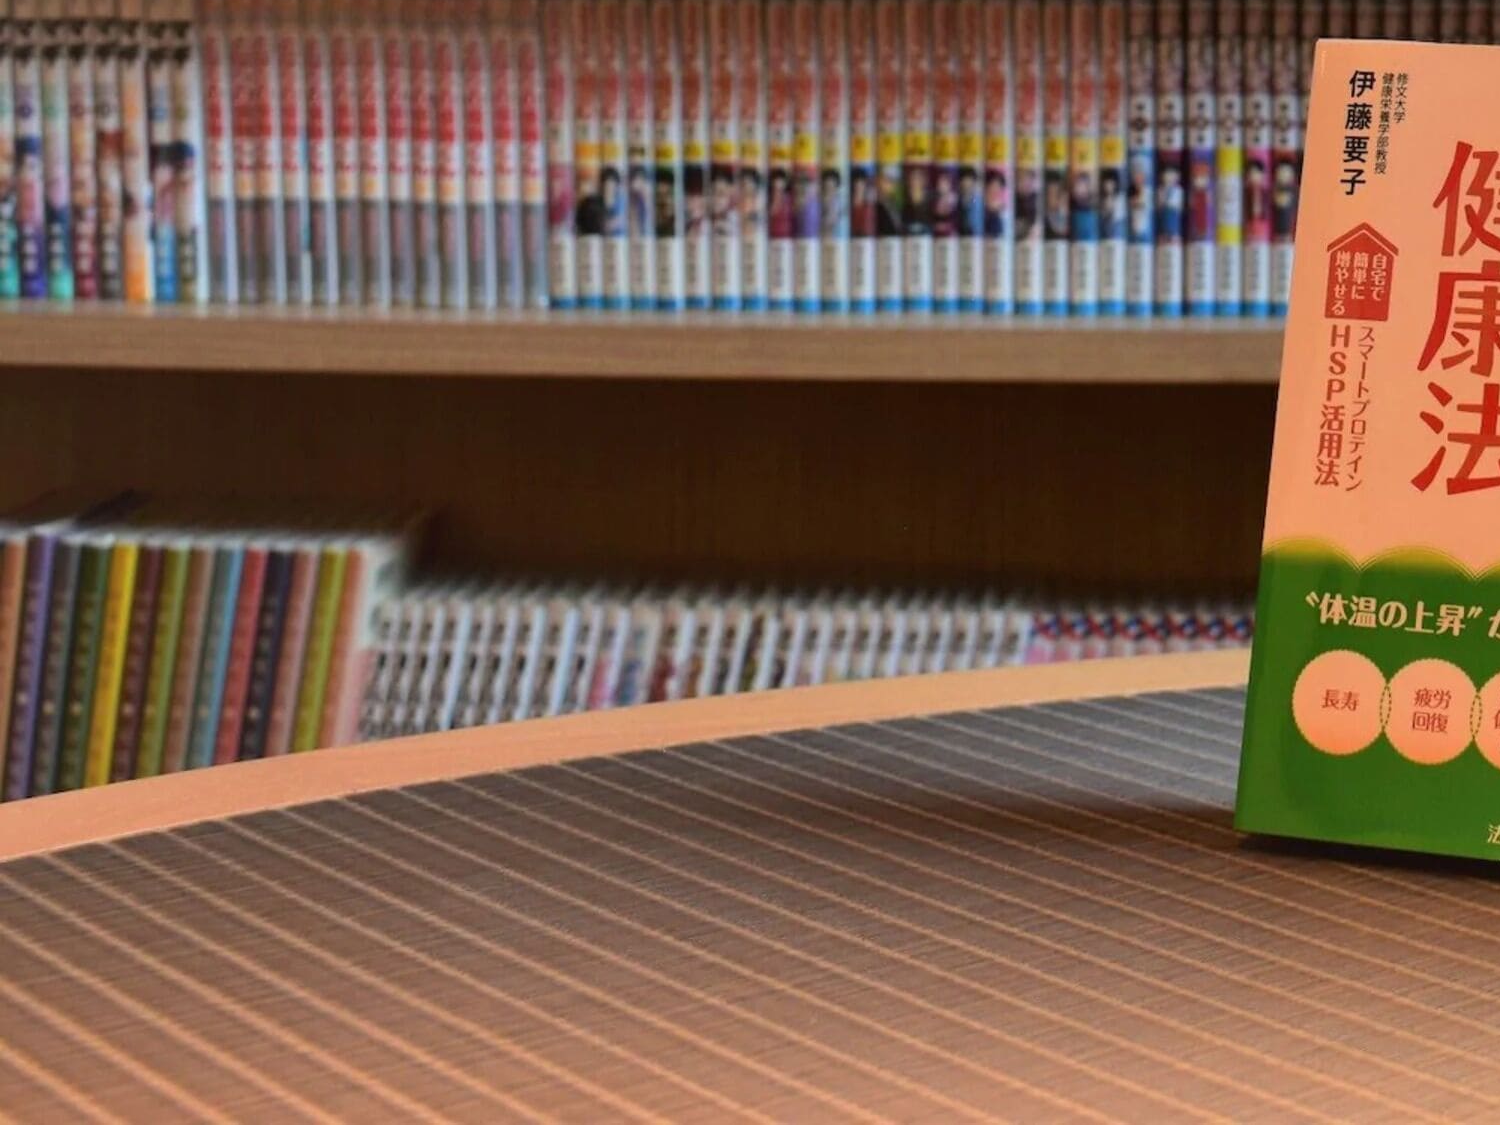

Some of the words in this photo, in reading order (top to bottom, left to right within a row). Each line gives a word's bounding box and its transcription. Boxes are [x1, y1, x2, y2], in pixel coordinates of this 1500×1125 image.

[1340, 70, 1376, 195] 伊藤要子
[1331, 250, 1351, 316] 増やせる
[1351, 251, 1369, 300] 簡単に
[1370, 253, 1388, 301] 自宅で
[1314, 325, 1351, 487] HSP活用法
[1345, 326, 1375, 492] スマートプロテイン
[1322, 689, 1361, 713] 長寿
[1411, 711, 1449, 735] 回復
[1413, 687, 1453, 711] 疲労
